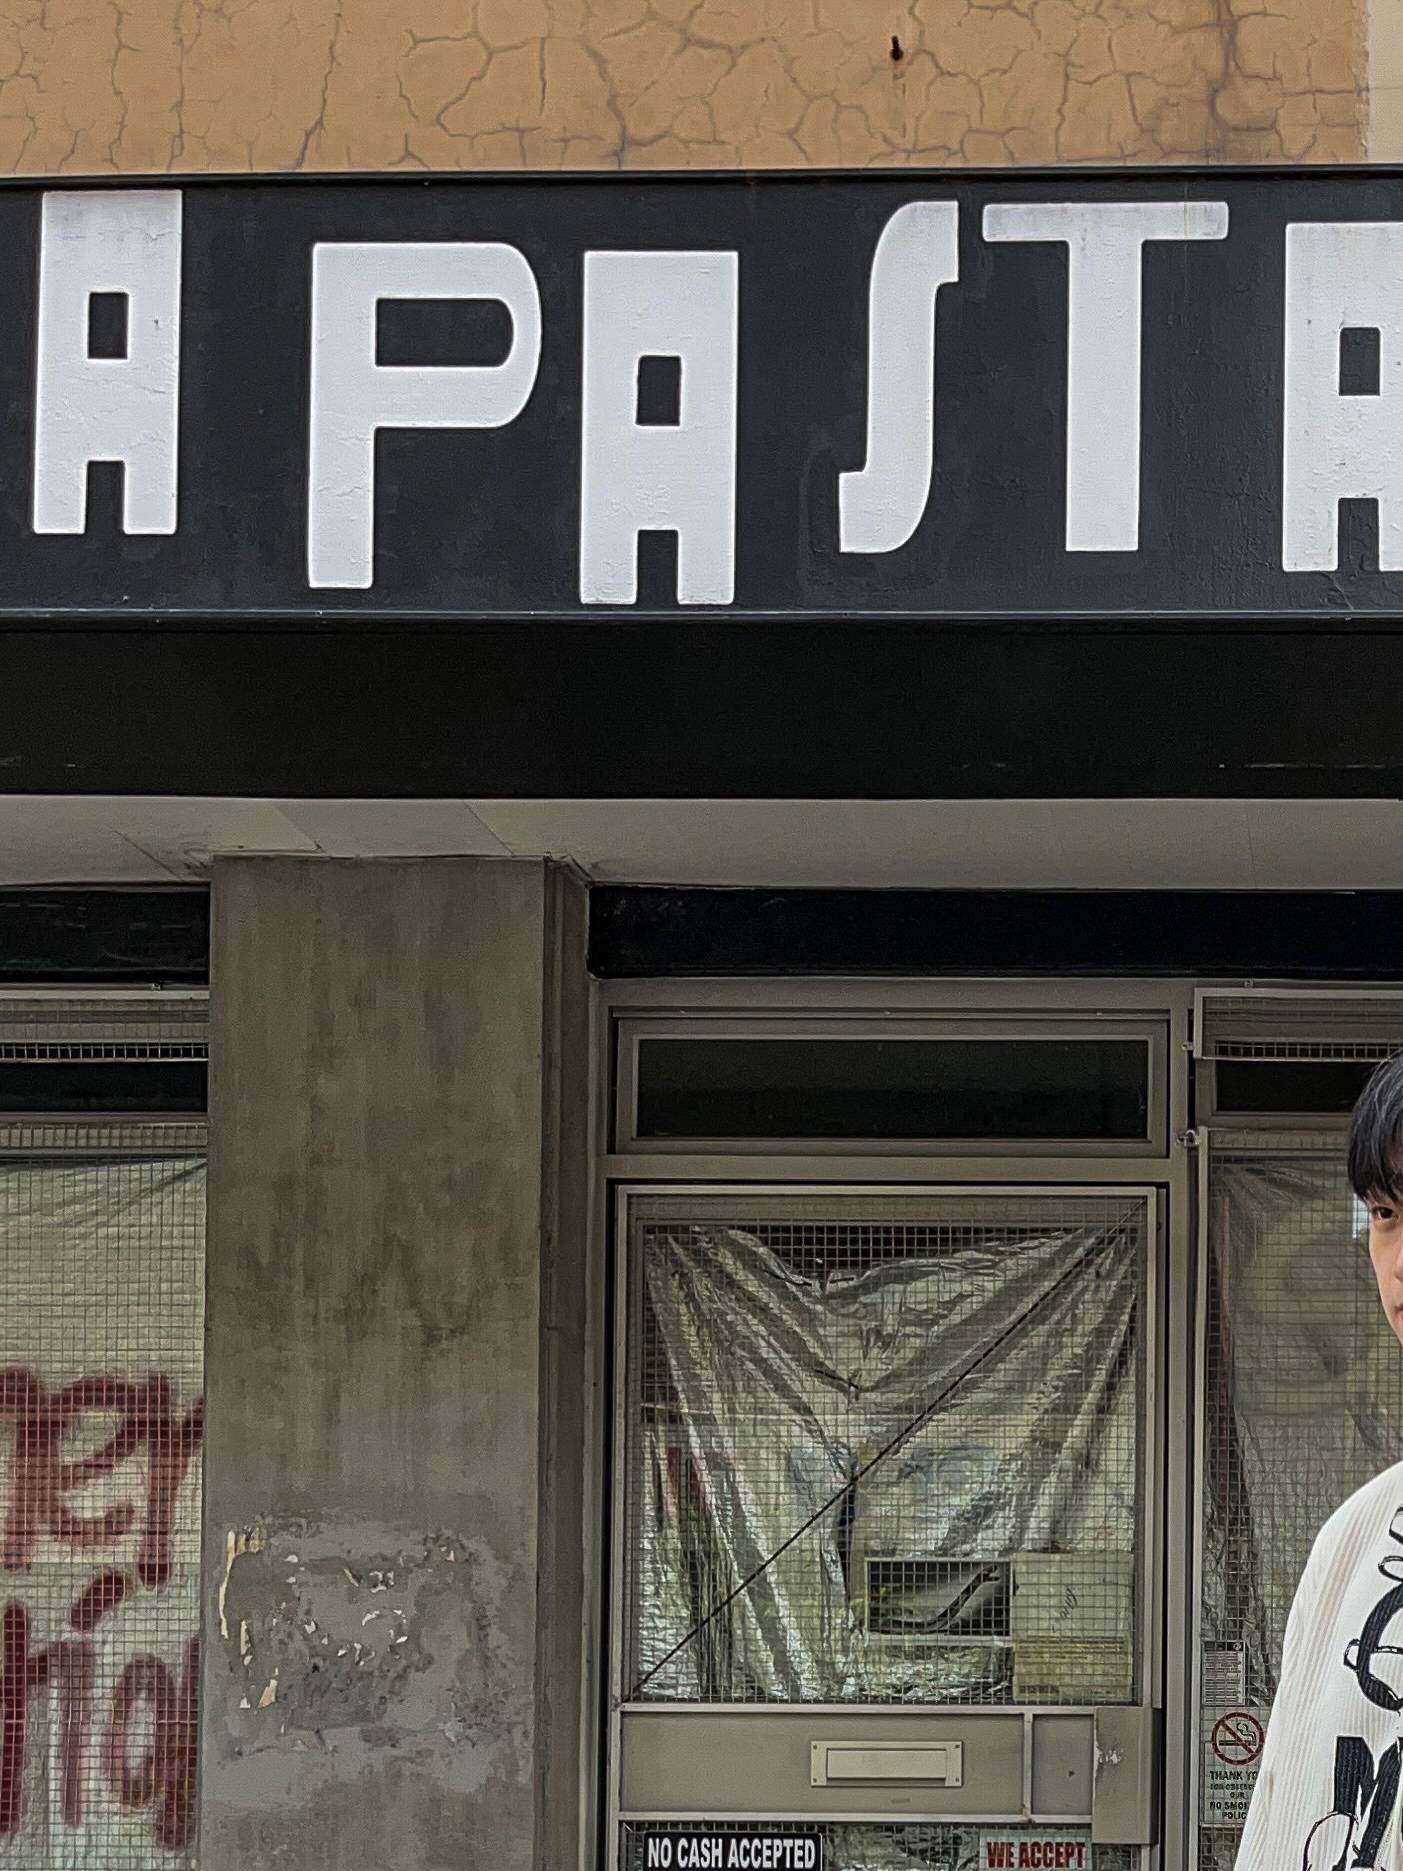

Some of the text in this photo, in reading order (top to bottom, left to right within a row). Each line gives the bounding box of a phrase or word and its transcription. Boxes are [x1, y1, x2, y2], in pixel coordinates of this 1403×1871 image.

[33, 190, 183, 535] A
[1210, 1771, 1243, 1781] THANK
[1209, 1801, 1222, 1810] NO
[648, 1837, 816, 1869] NO CASH ACCEPTED
[986, 1842, 1086, 1869] WE ACCEPT
